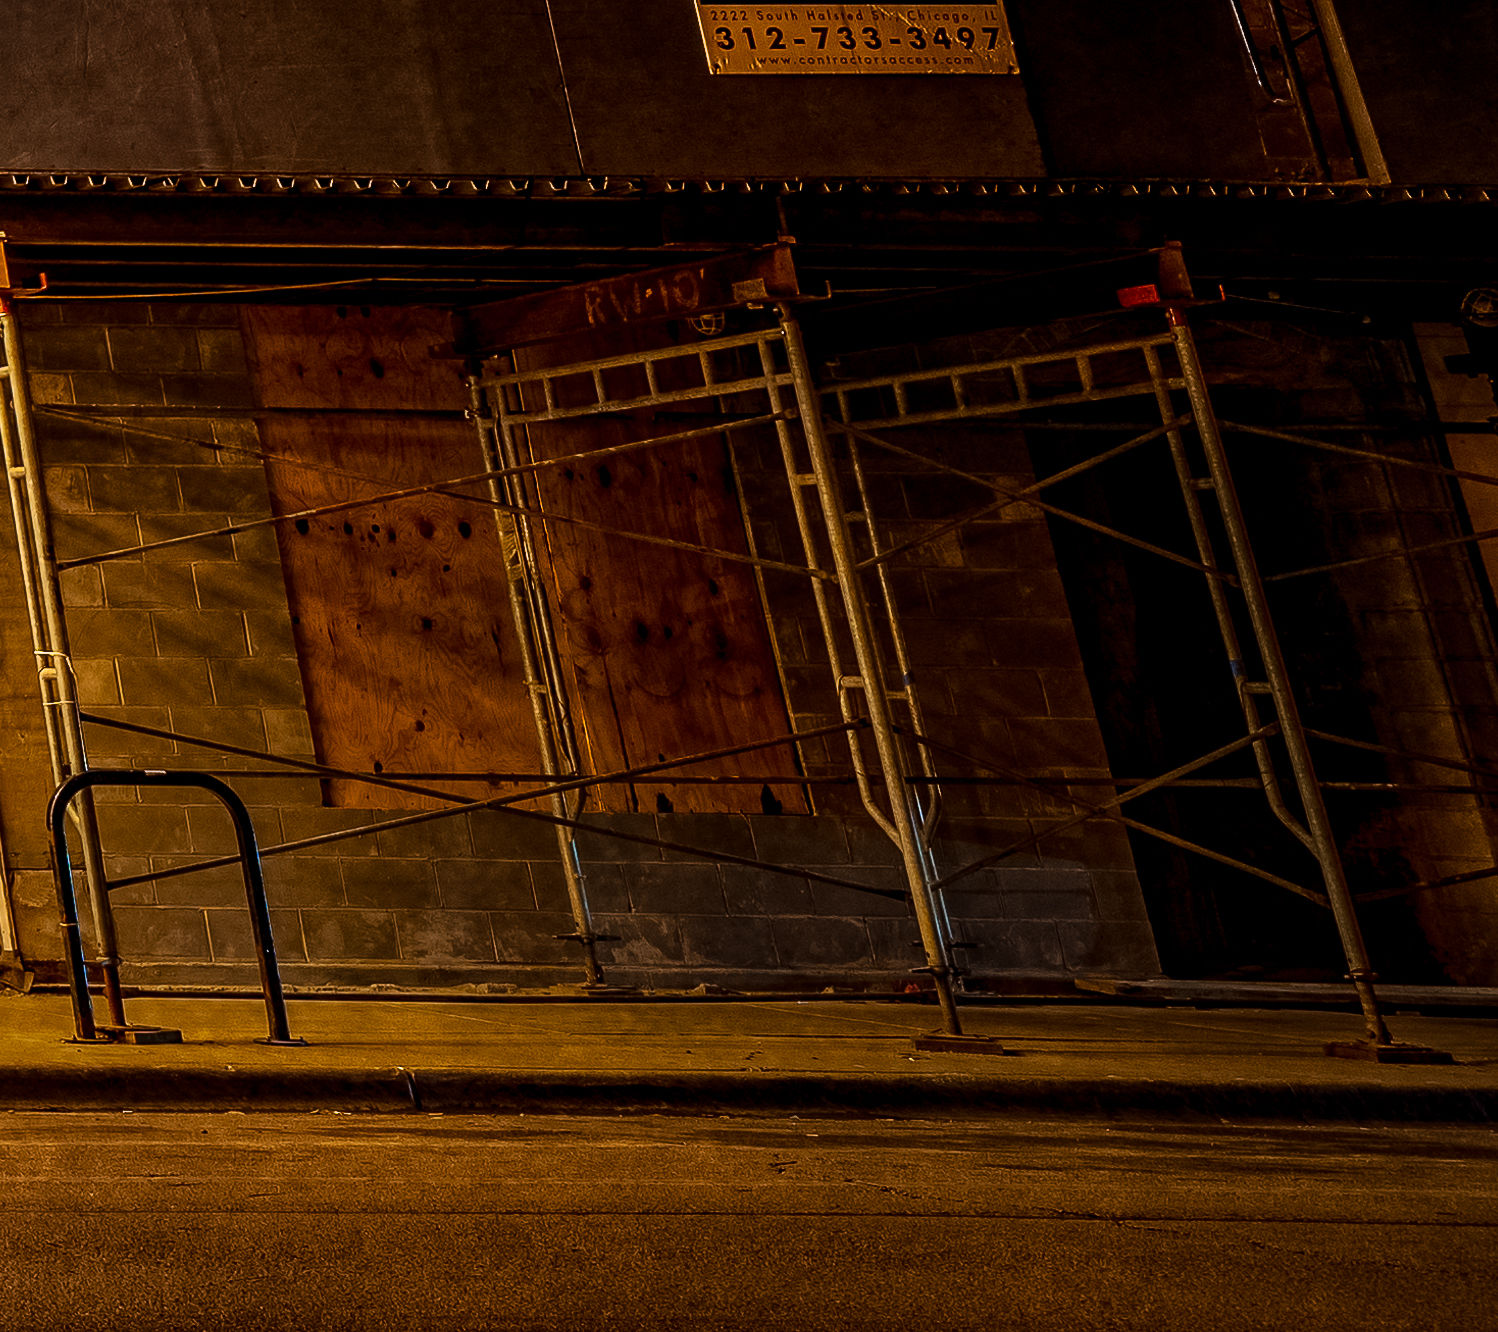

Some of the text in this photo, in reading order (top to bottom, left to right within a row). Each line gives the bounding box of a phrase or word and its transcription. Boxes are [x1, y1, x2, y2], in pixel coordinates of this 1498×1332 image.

[710, 10, 749, 21] 2222
[756, 10, 798, 21] South
[807, 10, 864, 21] Halsted
[906, 10, 976, 24] Chicago,
[984, 10, 998, 21] IL
[716, 26, 1000, 51] 312-733-3497
[756, 56, 974, 66] www.contractorsaccess.com
